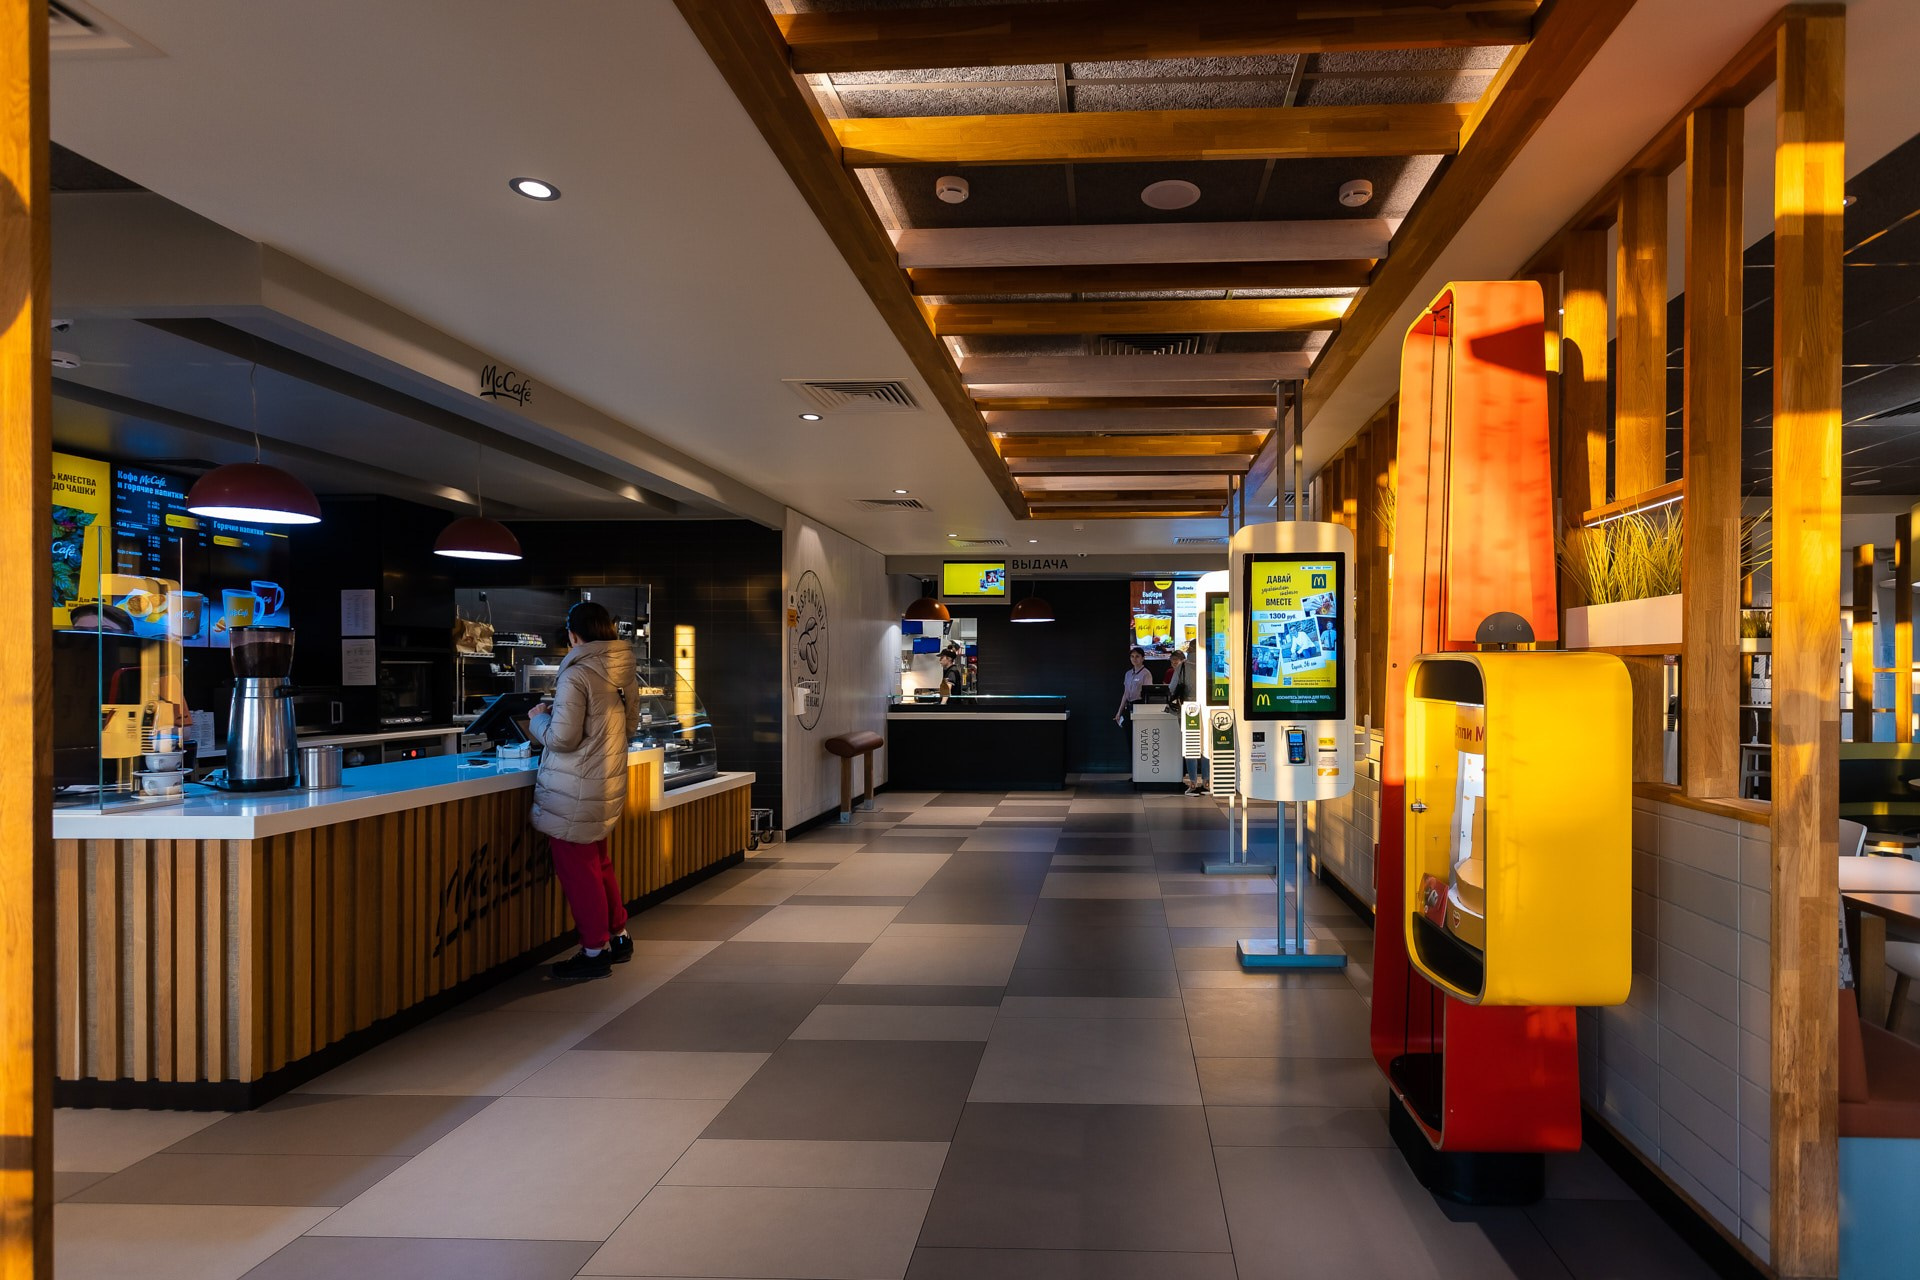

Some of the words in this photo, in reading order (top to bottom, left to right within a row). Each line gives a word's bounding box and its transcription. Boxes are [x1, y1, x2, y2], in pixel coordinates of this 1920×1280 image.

[57, 473, 97, 487] КАЧЕСТВА
[117, 470, 138, 482] Кофе
[52, 482, 65, 491] ДО
[65, 483, 96, 496] ЧАШКИ
[1012, 559, 1068, 570] ВЫДАЧА
[1266, 573, 1291, 584] ДАВАЙ
[1265, 598, 1292, 606] ВМЕСТЕ
[1140, 728, 1149, 762] ОПЛАТА
[1152, 728, 1160, 767] КИОСКОВ
